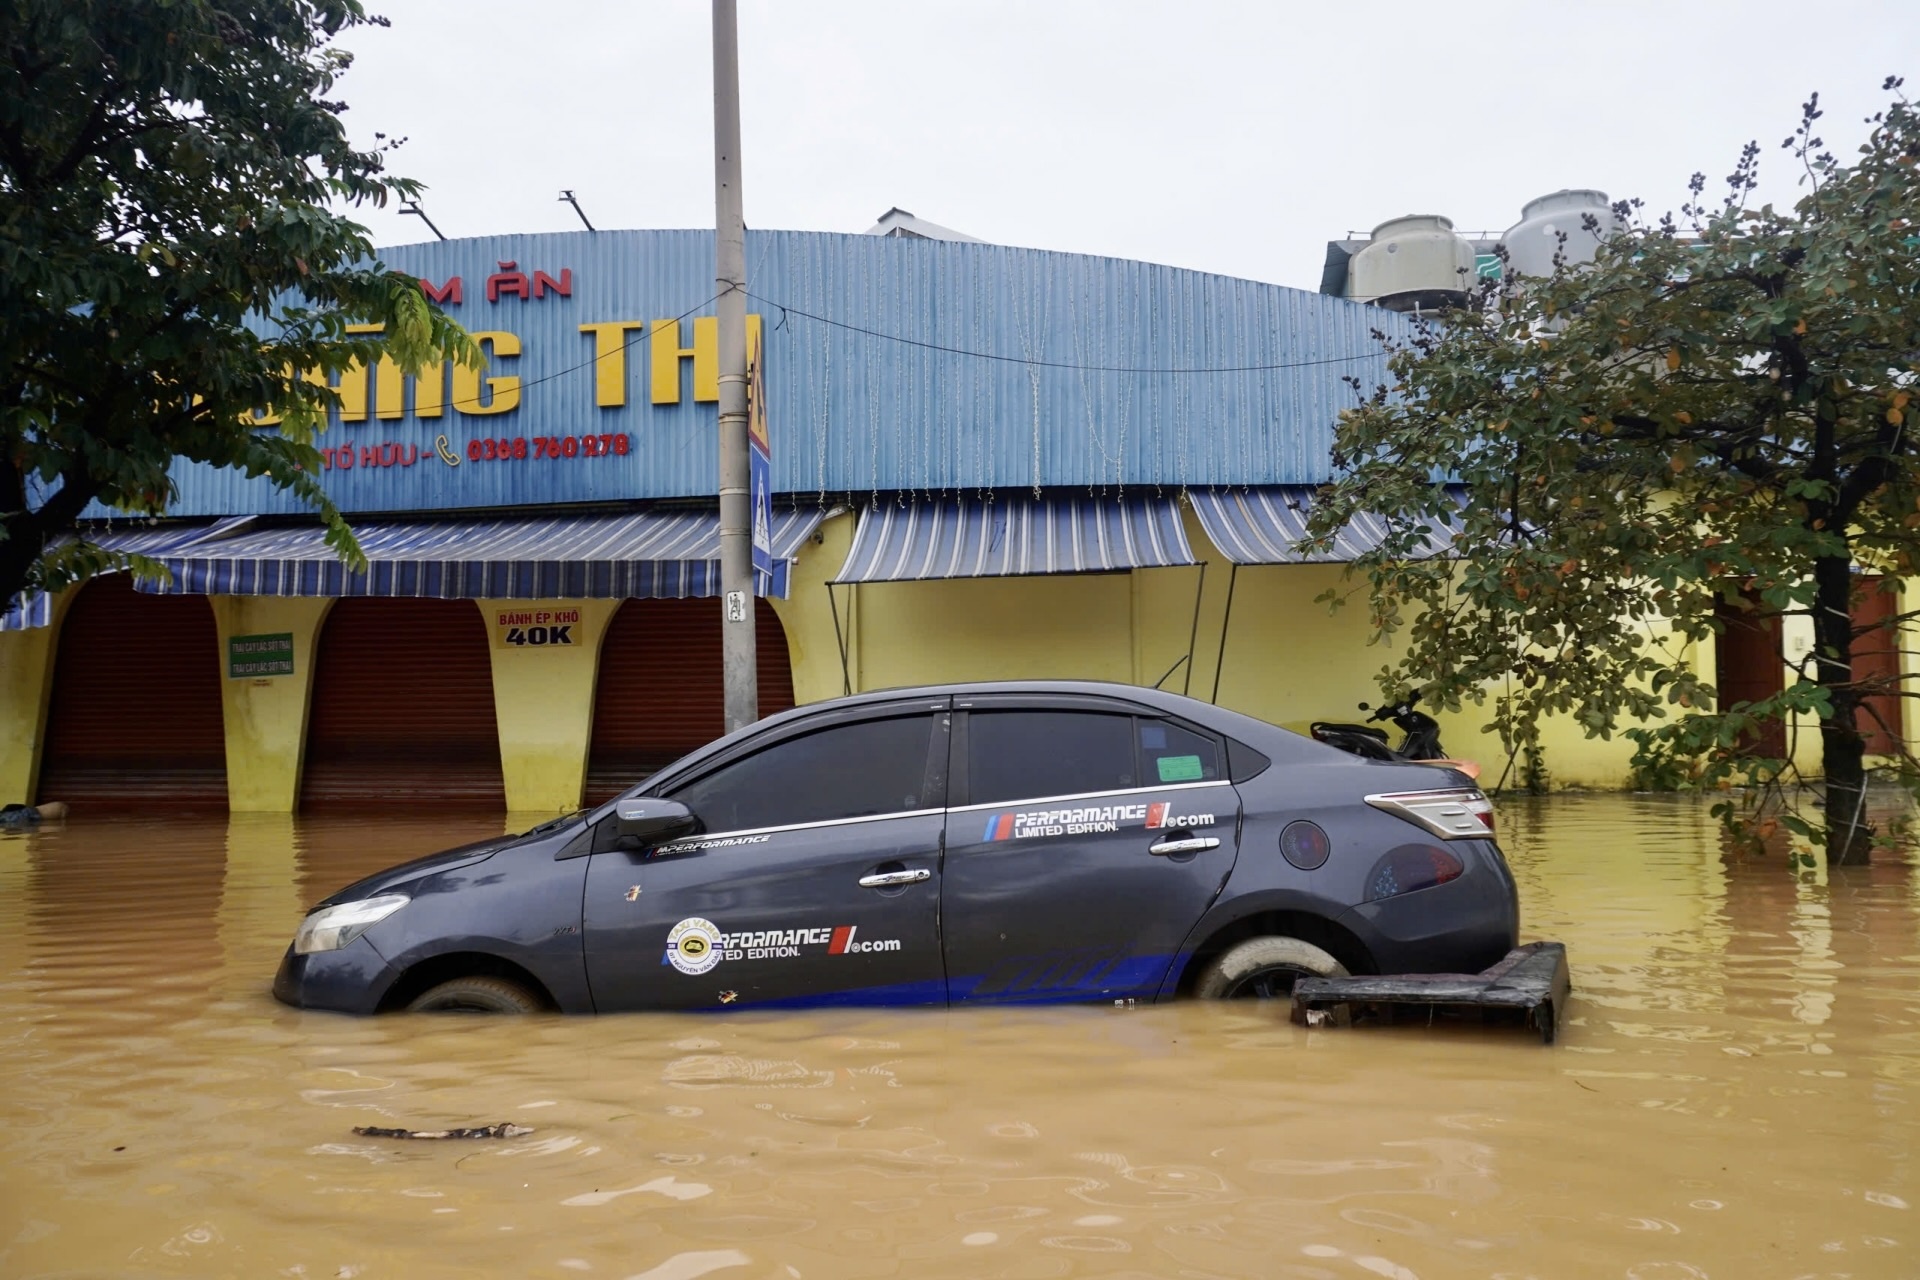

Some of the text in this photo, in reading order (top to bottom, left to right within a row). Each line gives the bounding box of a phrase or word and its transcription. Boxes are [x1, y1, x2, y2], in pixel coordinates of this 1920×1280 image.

[487, 260, 571, 302] ĂN
[319, 440, 355, 470] TỐ
[360, 440, 416, 467] HỮU
[467, 437, 527, 461] 0368
[533, 435, 575, 459] 760
[582, 433, 631, 457] 278
[499, 612, 532, 626] BÁNH
[536, 611, 551, 624] ÉP
[506, 626, 572, 646] 40K
[1014, 804, 1147, 827] PERFORMANCE
[1015, 823, 1063, 839] LIMITED
[721, 927, 832, 949] RFORMANCE
